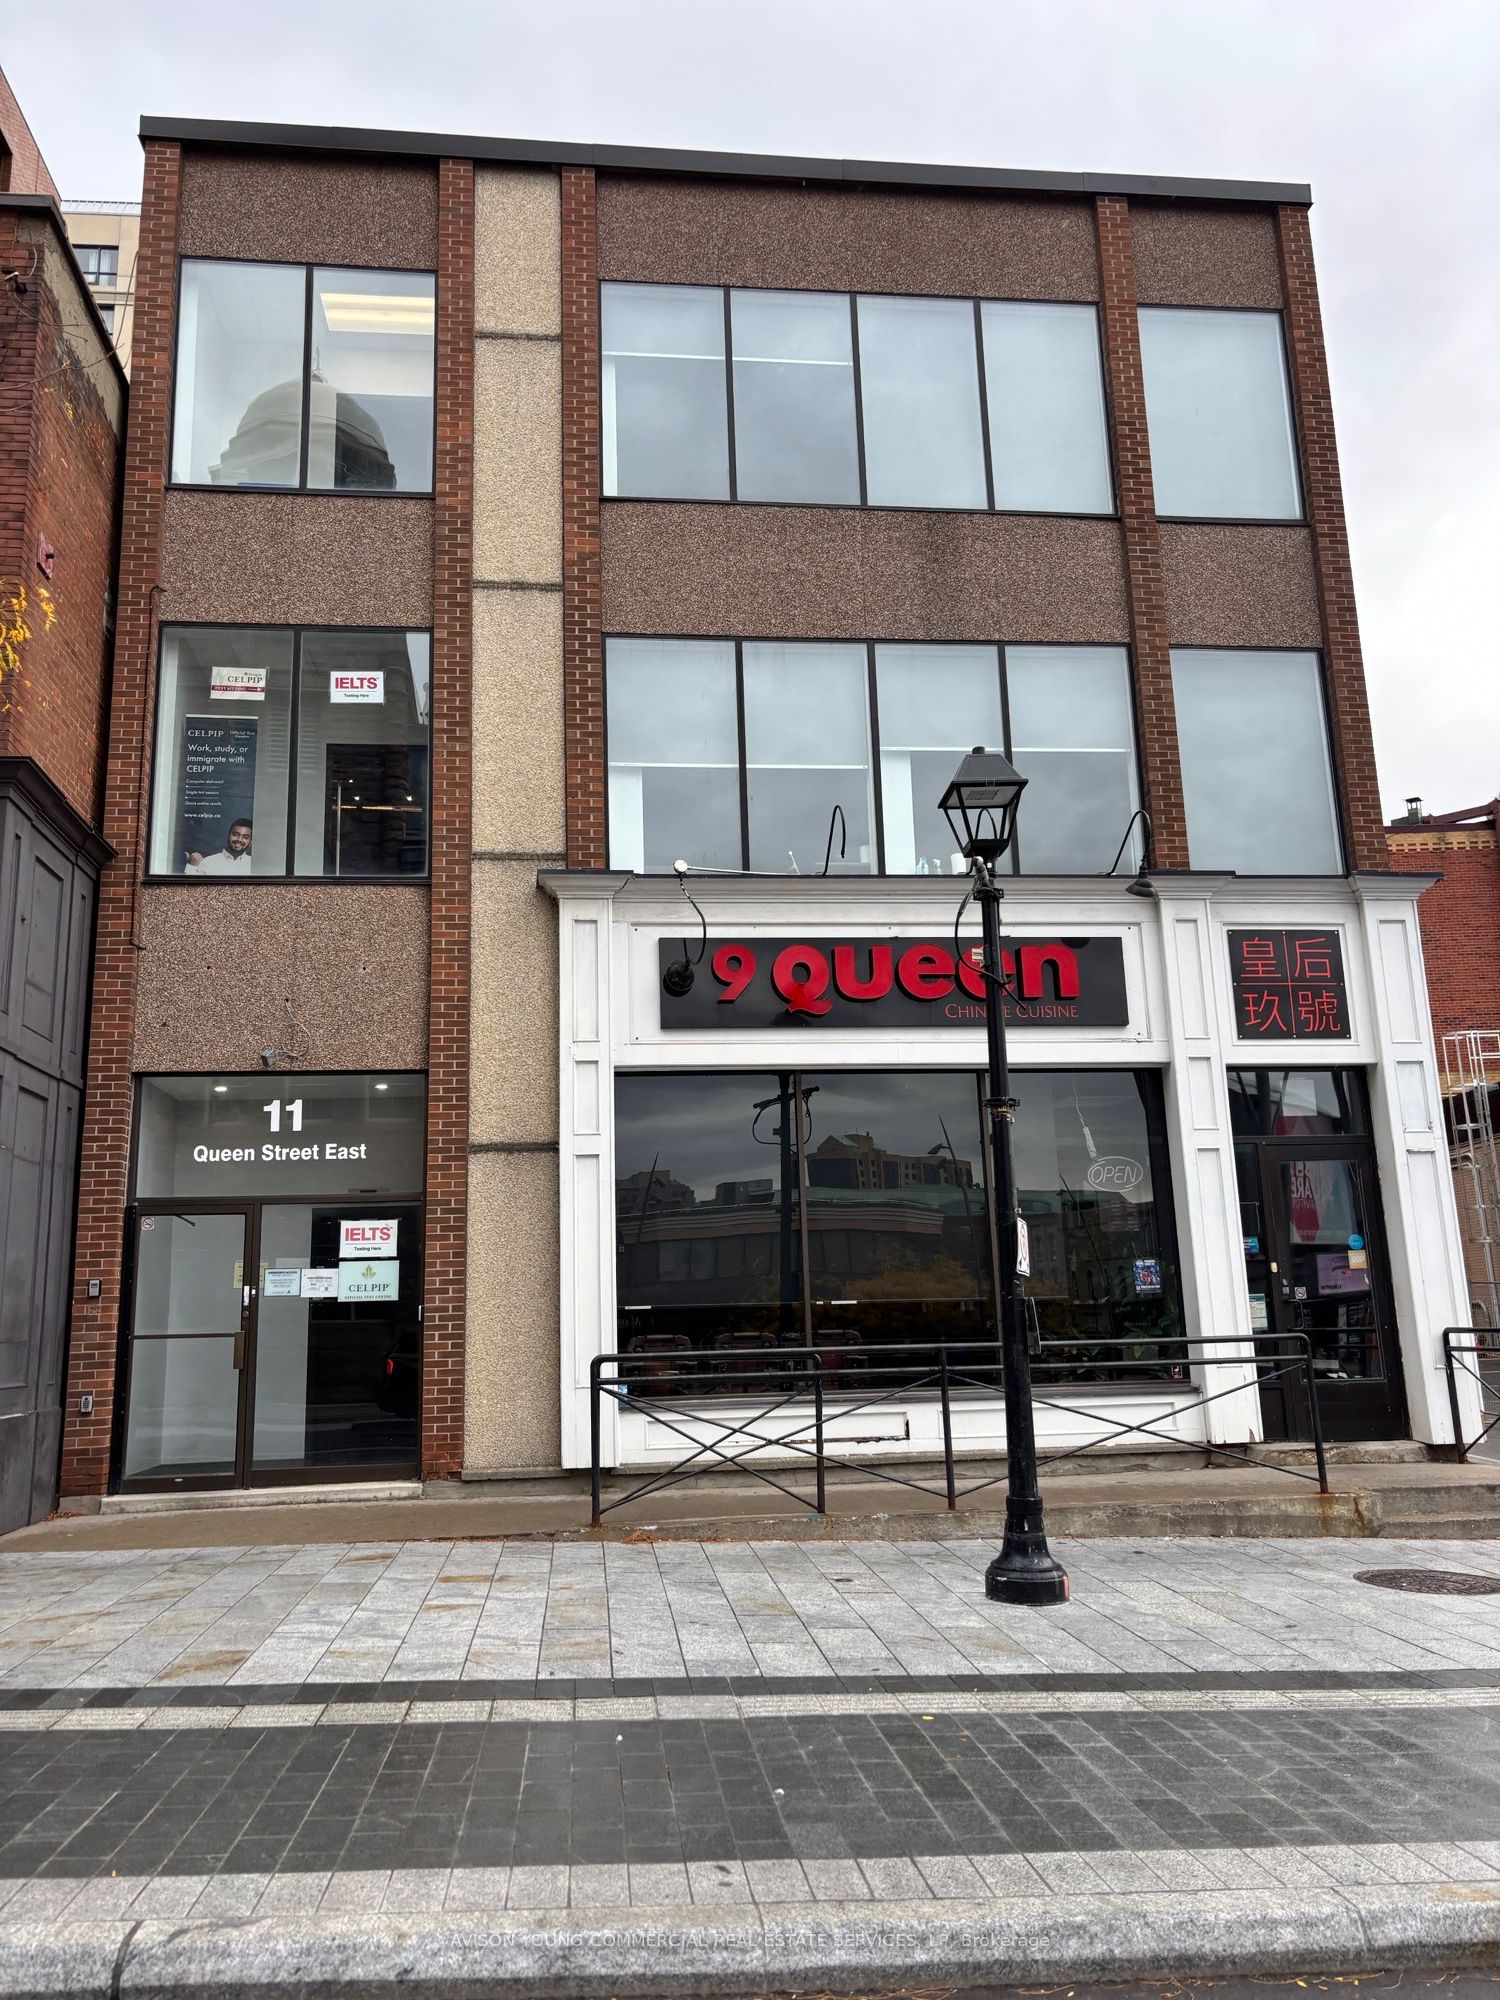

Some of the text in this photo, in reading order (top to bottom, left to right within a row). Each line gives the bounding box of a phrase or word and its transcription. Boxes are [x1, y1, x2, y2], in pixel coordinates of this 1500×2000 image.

[227, 675, 263, 683] CELPIP
[335, 677, 378, 689] IELTS
[187, 729, 224, 737] CELPIP
[187, 743, 212, 752] Work,
[214, 744, 237, 754] study,
[187, 754, 245, 764] immigrate with
[186, 764, 215, 773] CELPIP
[1240, 936, 1332, 978] 皇后
[711, 943, 757, 1003] 9
[944, 1003, 1012, 1018] CHINE
[1242, 989, 1341, 1032] 玖號
[263, 1099, 303, 1132] 11
[193, 1143, 367, 1163] Queen Street East
[1091, 1165, 1138, 1183] OPEN
[345, 1226, 391, 1242] IELTS
[348, 1283, 390, 1292] CELPIP
